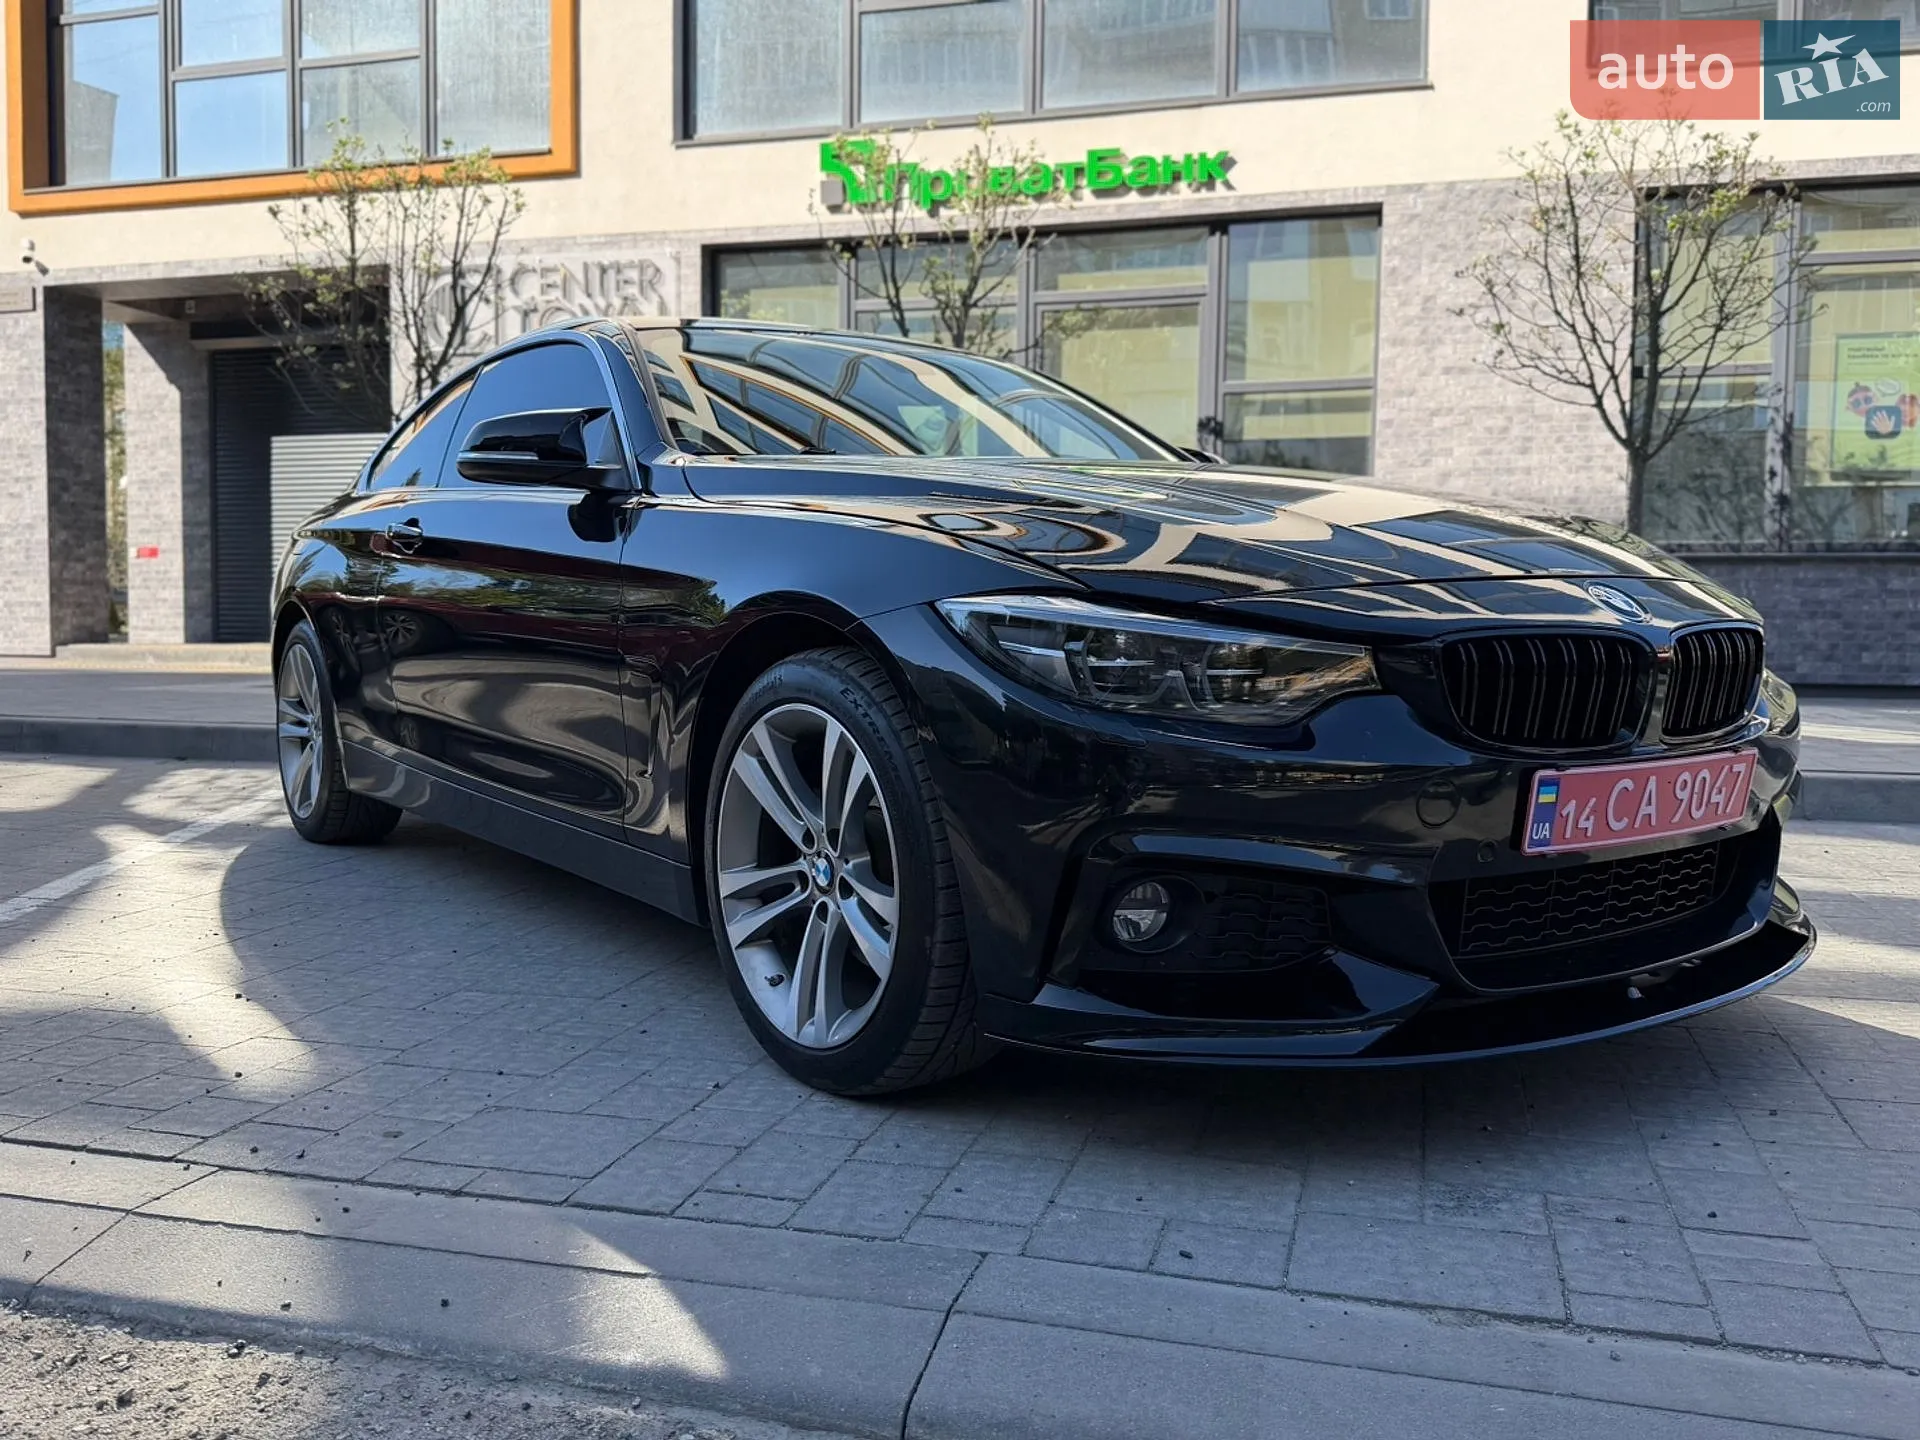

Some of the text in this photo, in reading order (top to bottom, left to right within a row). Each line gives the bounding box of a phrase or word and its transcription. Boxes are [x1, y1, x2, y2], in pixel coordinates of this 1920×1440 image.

[508, 257, 666, 303] CENTER
[1560, 762, 1747, 839] 14 CA 9047
[1532, 822, 1550, 840] UA
